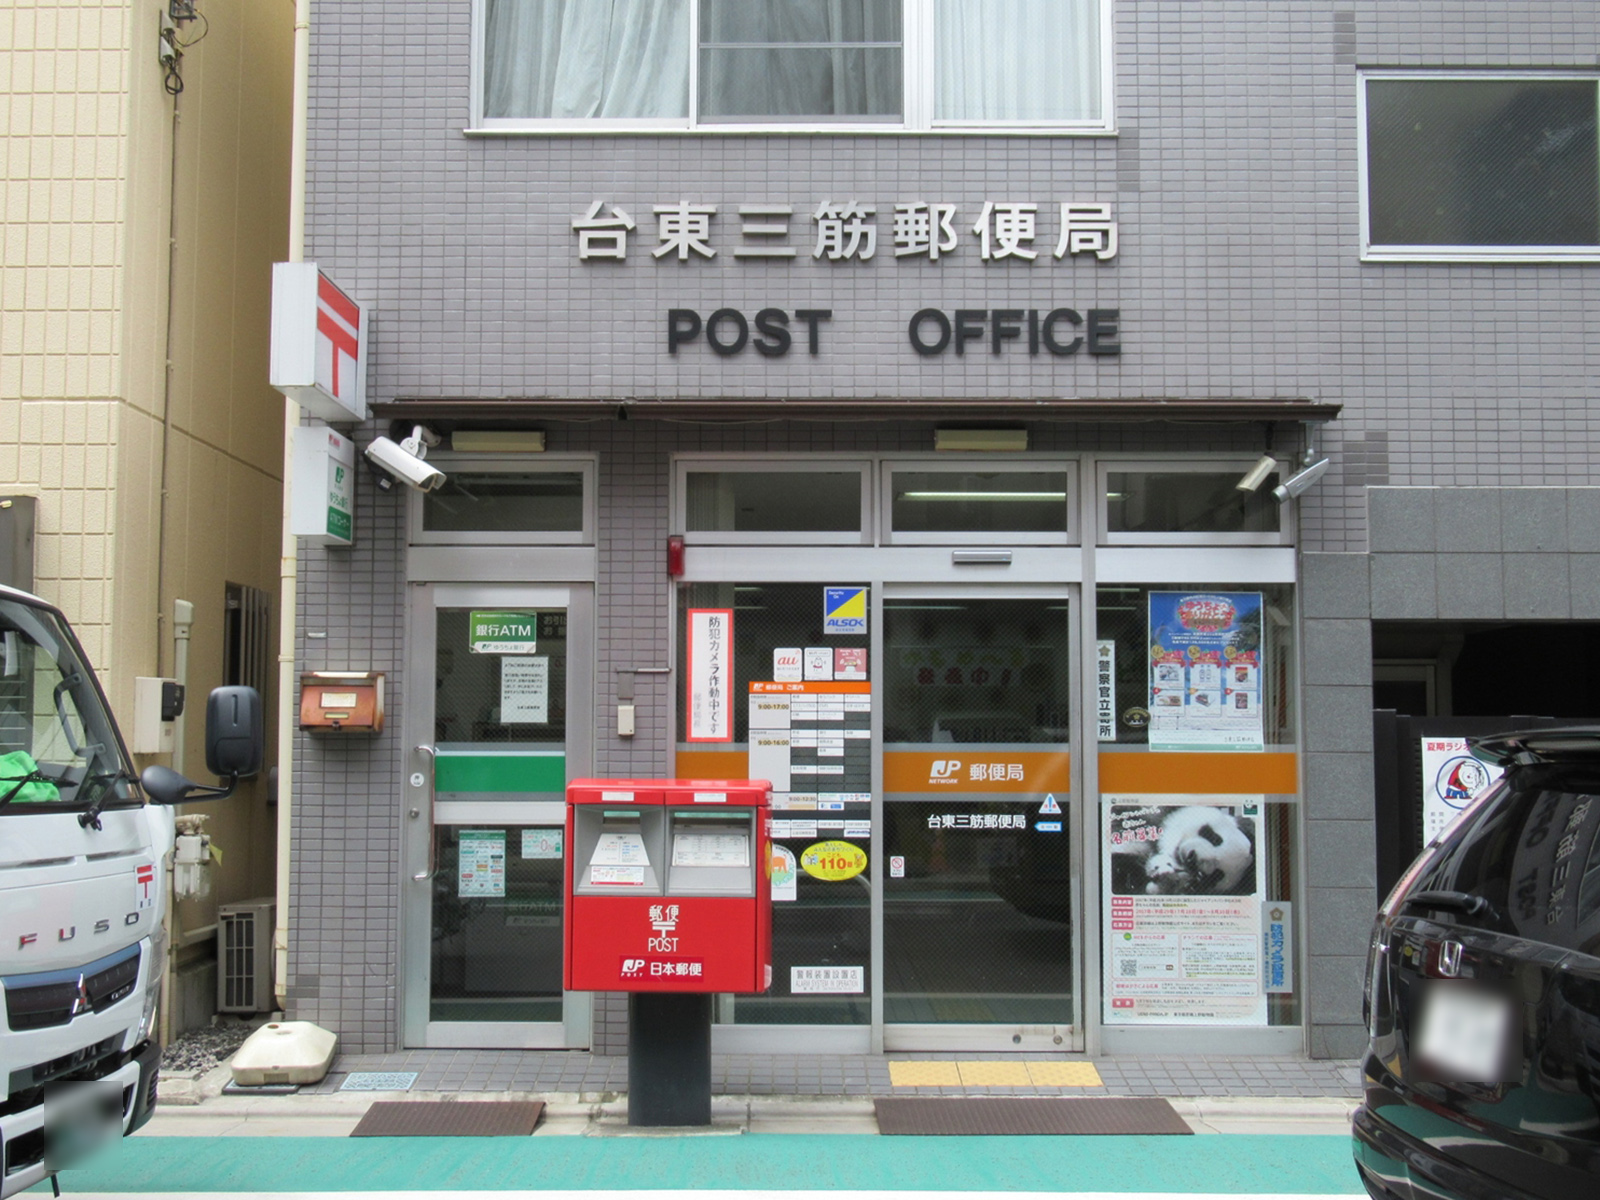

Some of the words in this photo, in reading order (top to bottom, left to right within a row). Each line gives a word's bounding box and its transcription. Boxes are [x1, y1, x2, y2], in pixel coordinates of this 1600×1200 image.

[572, 200, 1119, 262] 台東三筋郵便局
[667, 307, 832, 357] POST
[908, 307, 1121, 357] OFFICE
[475, 624, 532, 637] 銀行ATM
[826, 618, 864, 628] ALSOK
[777, 656, 799, 666] au
[708, 616, 721, 735] 防犯カメラ作動中です
[969, 763, 1025, 782] 郵便局
[927, 814, 1027, 830] 台東三筋郵便局
[649, 904, 679, 922] 郵便
[18, 911, 140, 949] FUSO
[647, 937, 679, 952] POST
[650, 962, 702, 976] 日本郵便
